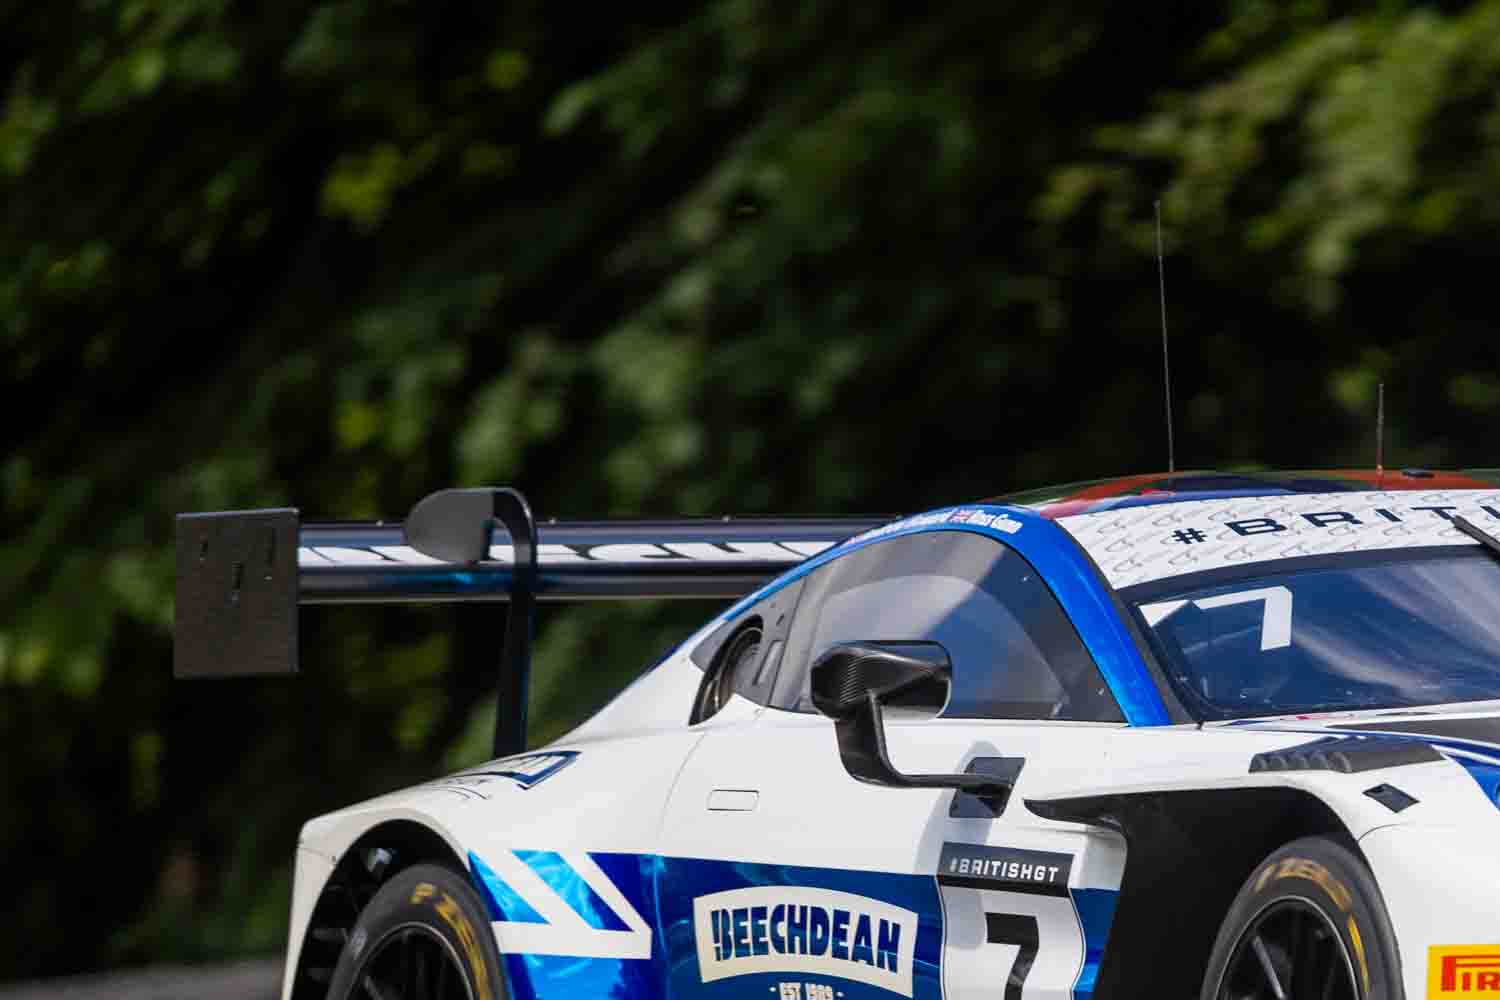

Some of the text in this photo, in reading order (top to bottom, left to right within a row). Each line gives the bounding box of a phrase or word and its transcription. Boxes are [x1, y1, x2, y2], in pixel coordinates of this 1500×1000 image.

[949, 857, 1059, 882] #BRITISHGT
[710, 903, 901, 975] BEECHDEAN
[779, 982, 801, 1000] EST
